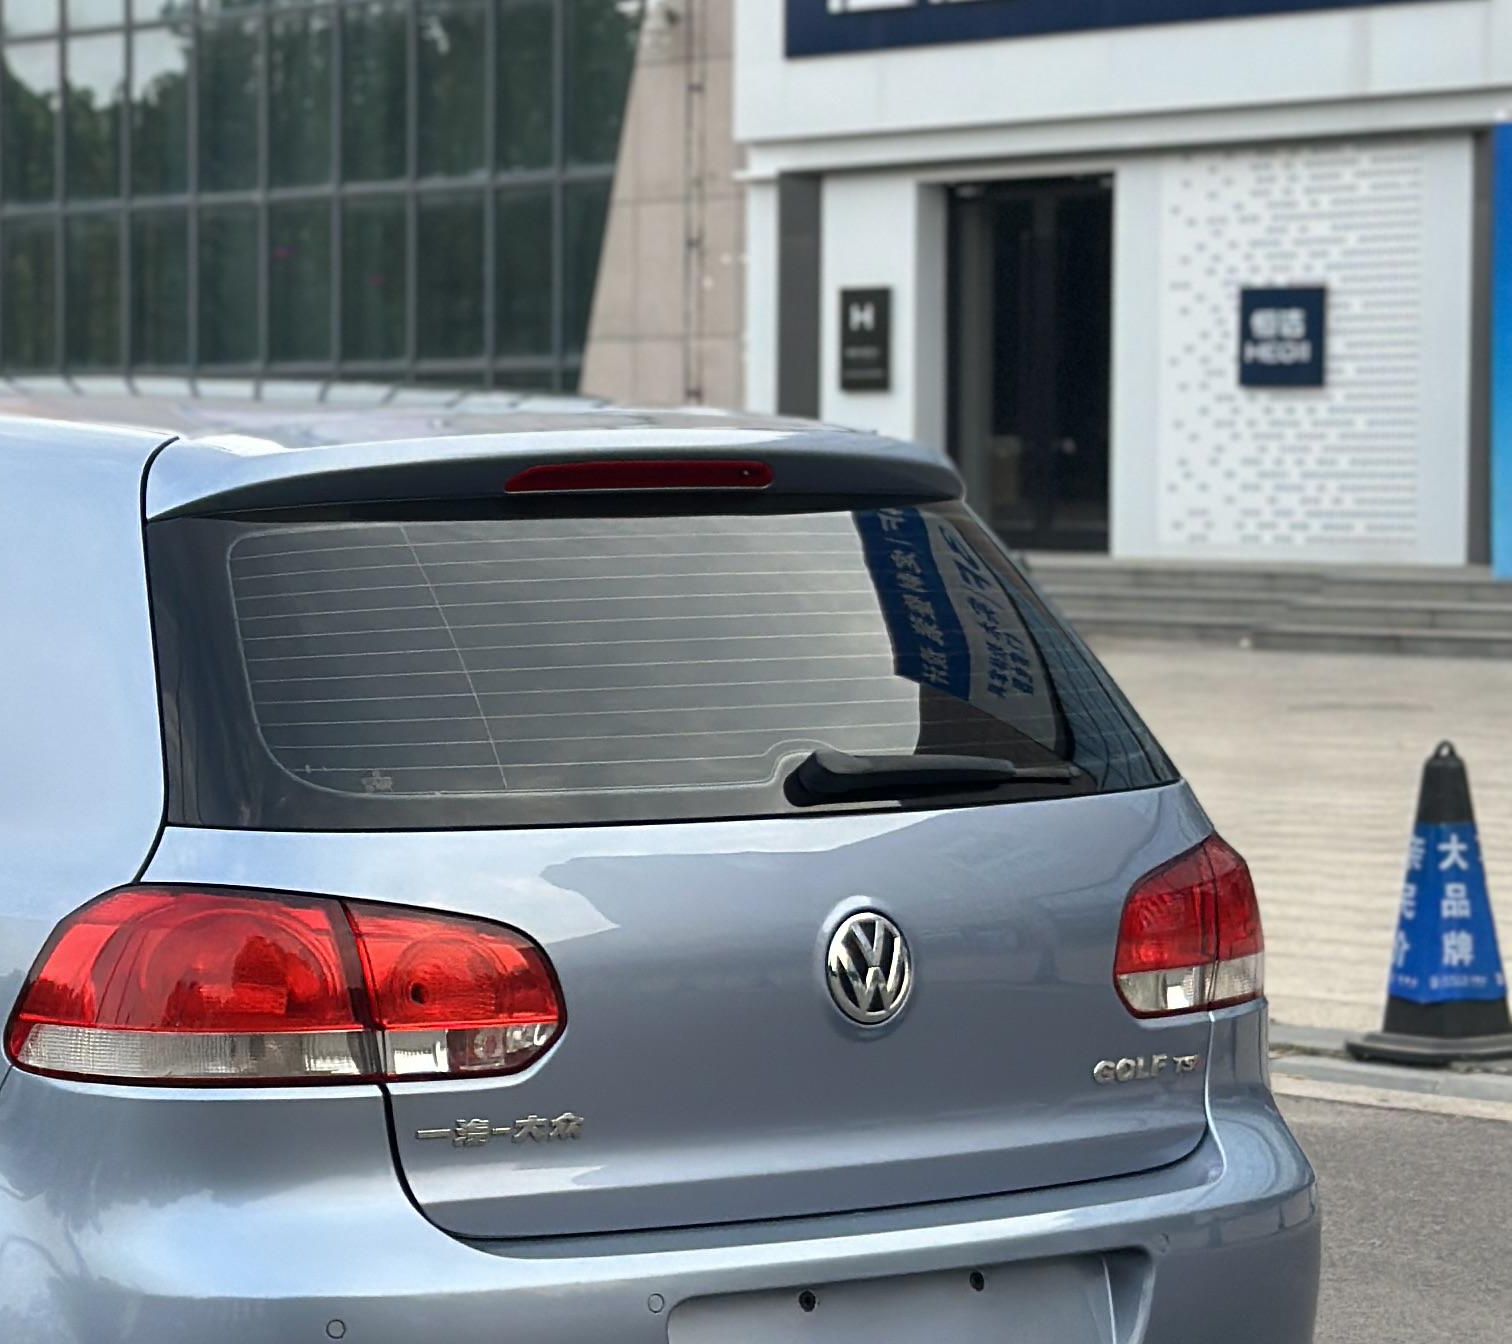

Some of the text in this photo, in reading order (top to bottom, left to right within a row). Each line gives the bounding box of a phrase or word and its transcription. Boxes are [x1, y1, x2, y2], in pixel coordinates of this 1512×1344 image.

[1437, 832, 1475, 968] 大品牌
[1093, 1054, 1168, 1085] GOLF
